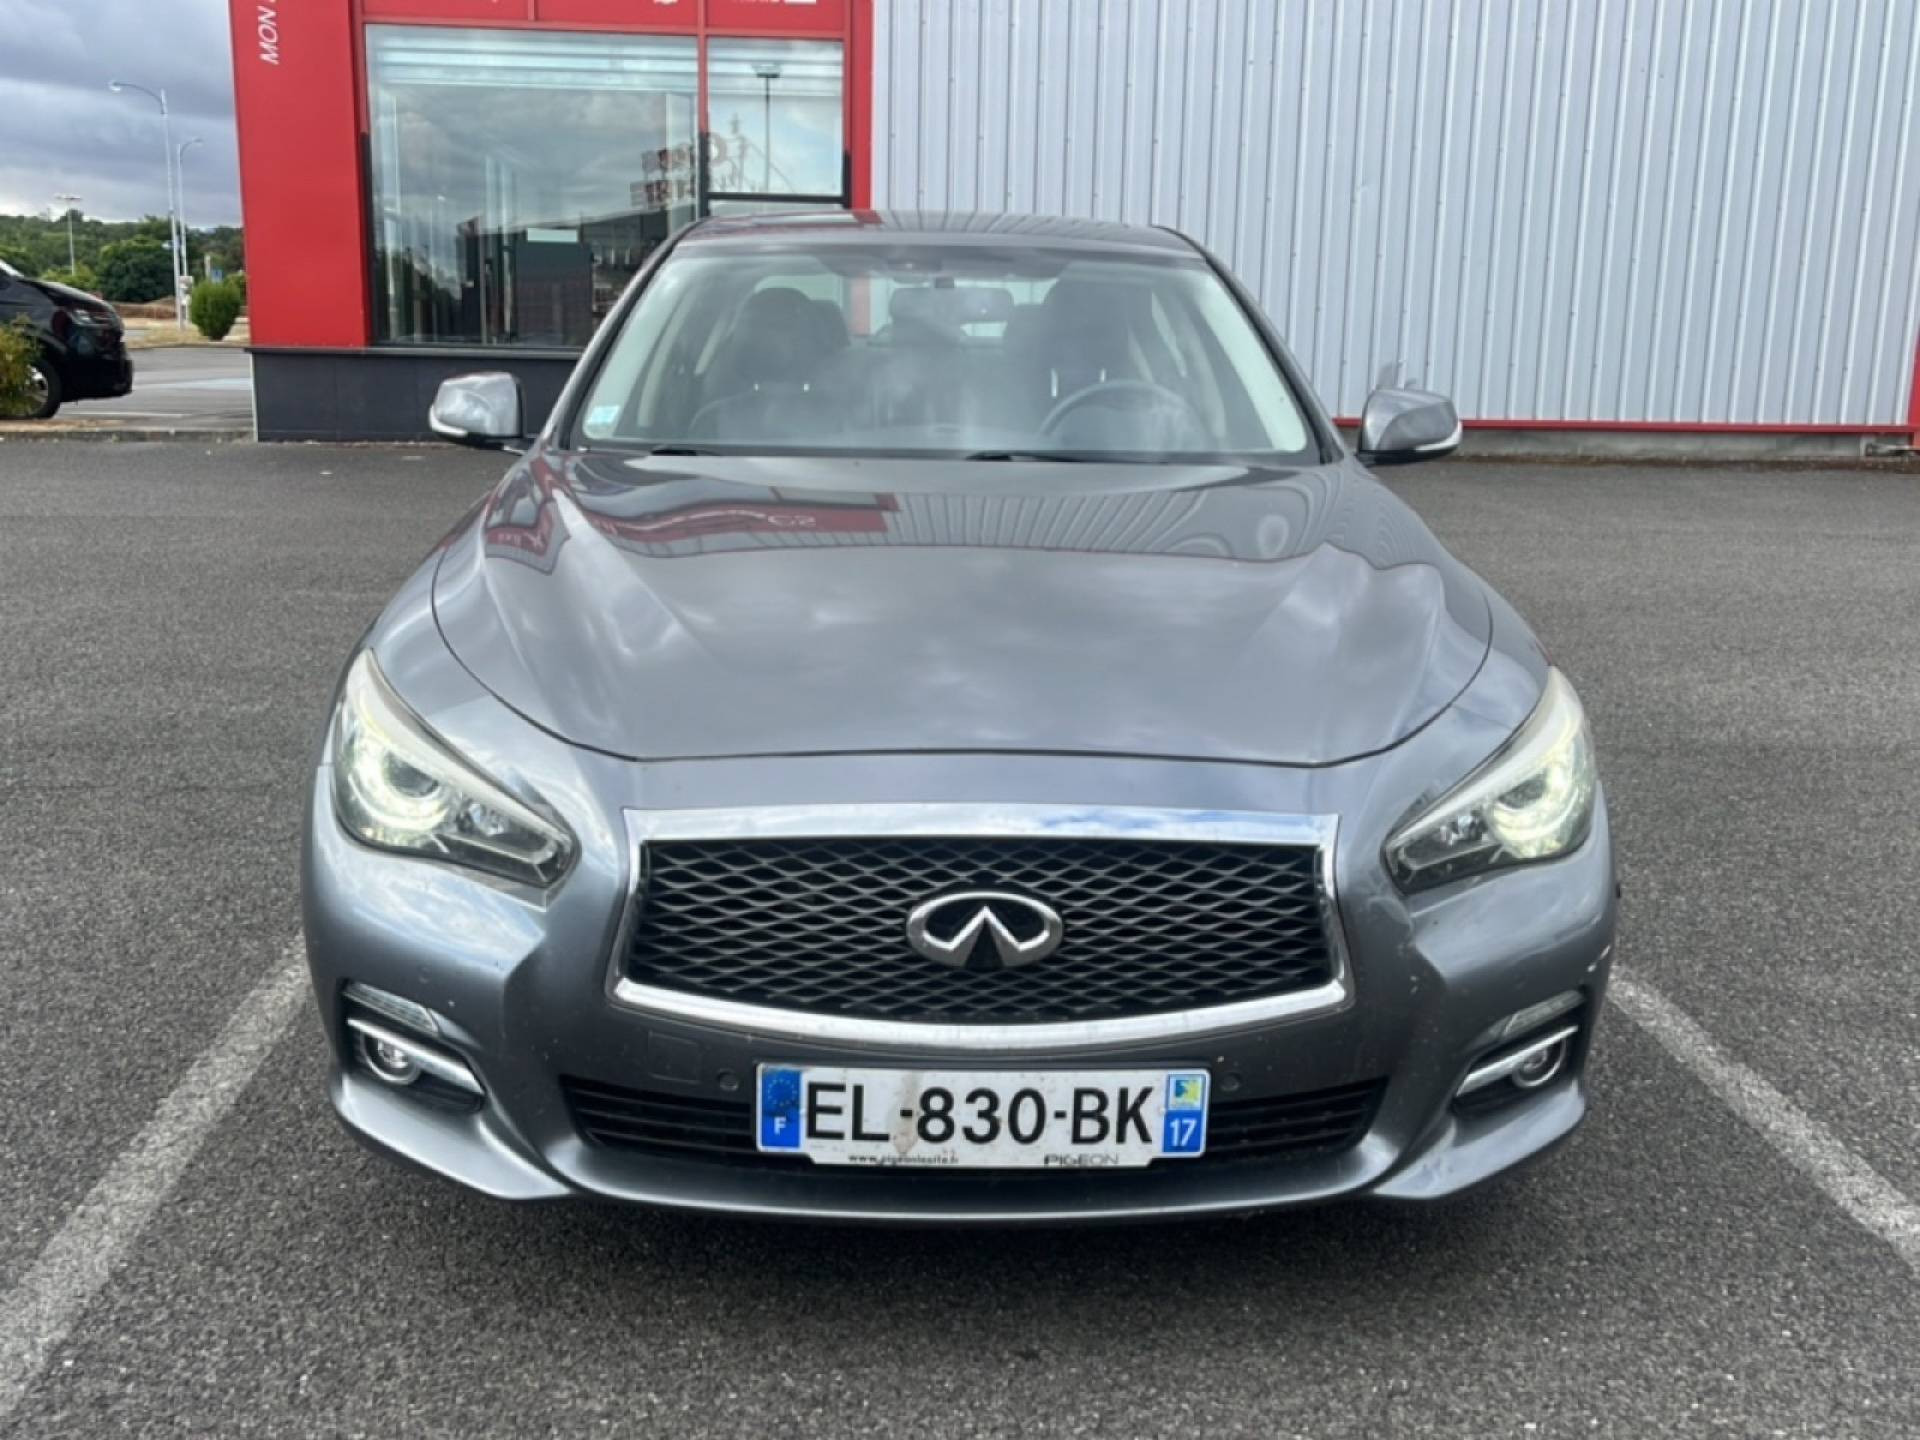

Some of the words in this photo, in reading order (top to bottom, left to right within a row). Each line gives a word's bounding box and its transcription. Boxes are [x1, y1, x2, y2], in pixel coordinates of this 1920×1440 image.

[257, 5, 279, 65] MON
[773, 1116, 787, 1135] F
[806, 1081, 1154, 1145] EL-830-BK
[1169, 1118, 1197, 1147] 17
